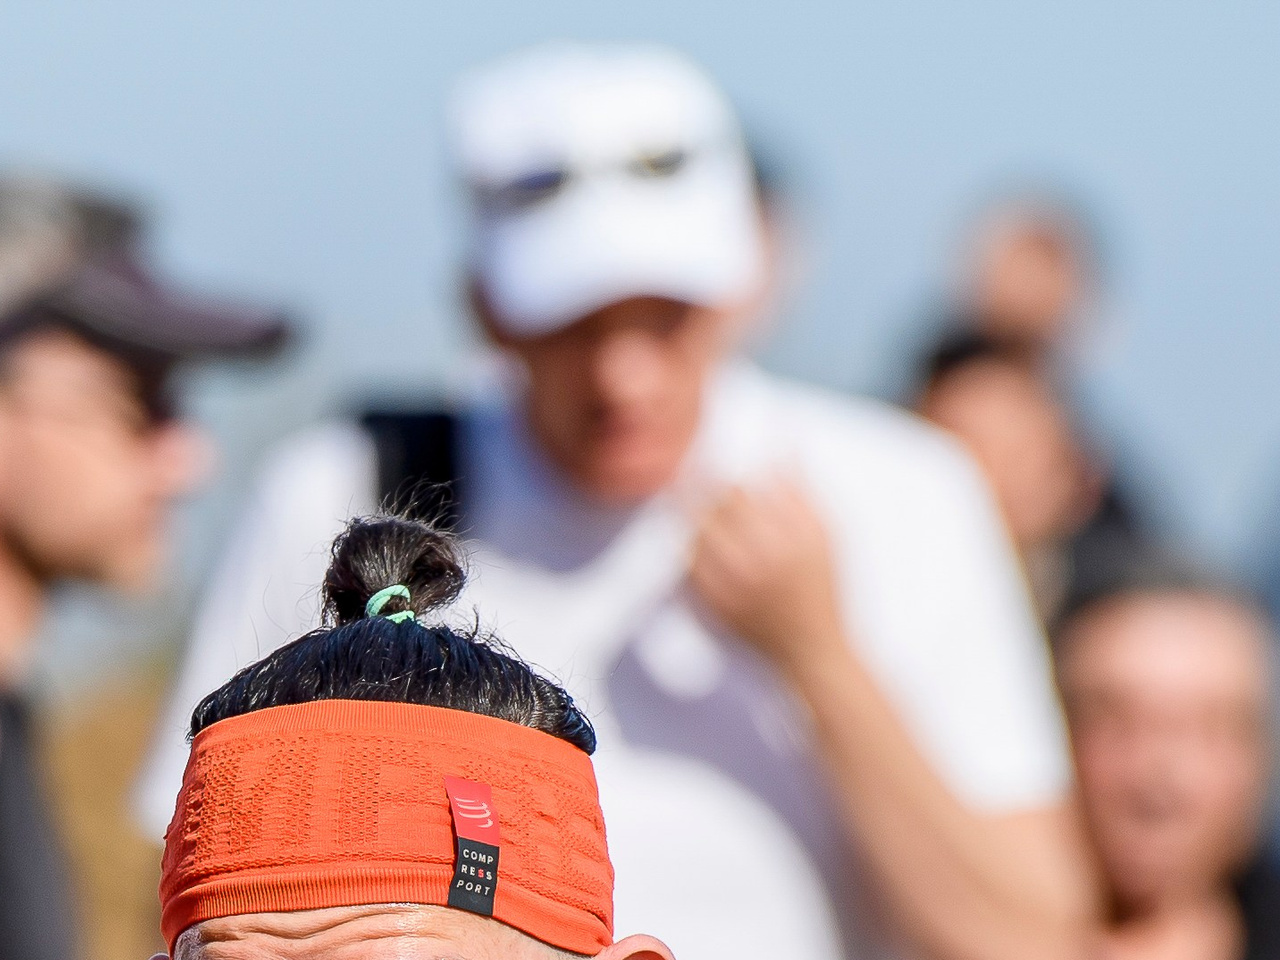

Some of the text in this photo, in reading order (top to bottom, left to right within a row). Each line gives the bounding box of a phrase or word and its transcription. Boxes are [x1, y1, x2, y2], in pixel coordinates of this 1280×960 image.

[462, 848, 494, 865] COMP
[461, 864, 493, 881] RESS
[456, 879, 491, 896] PORT
